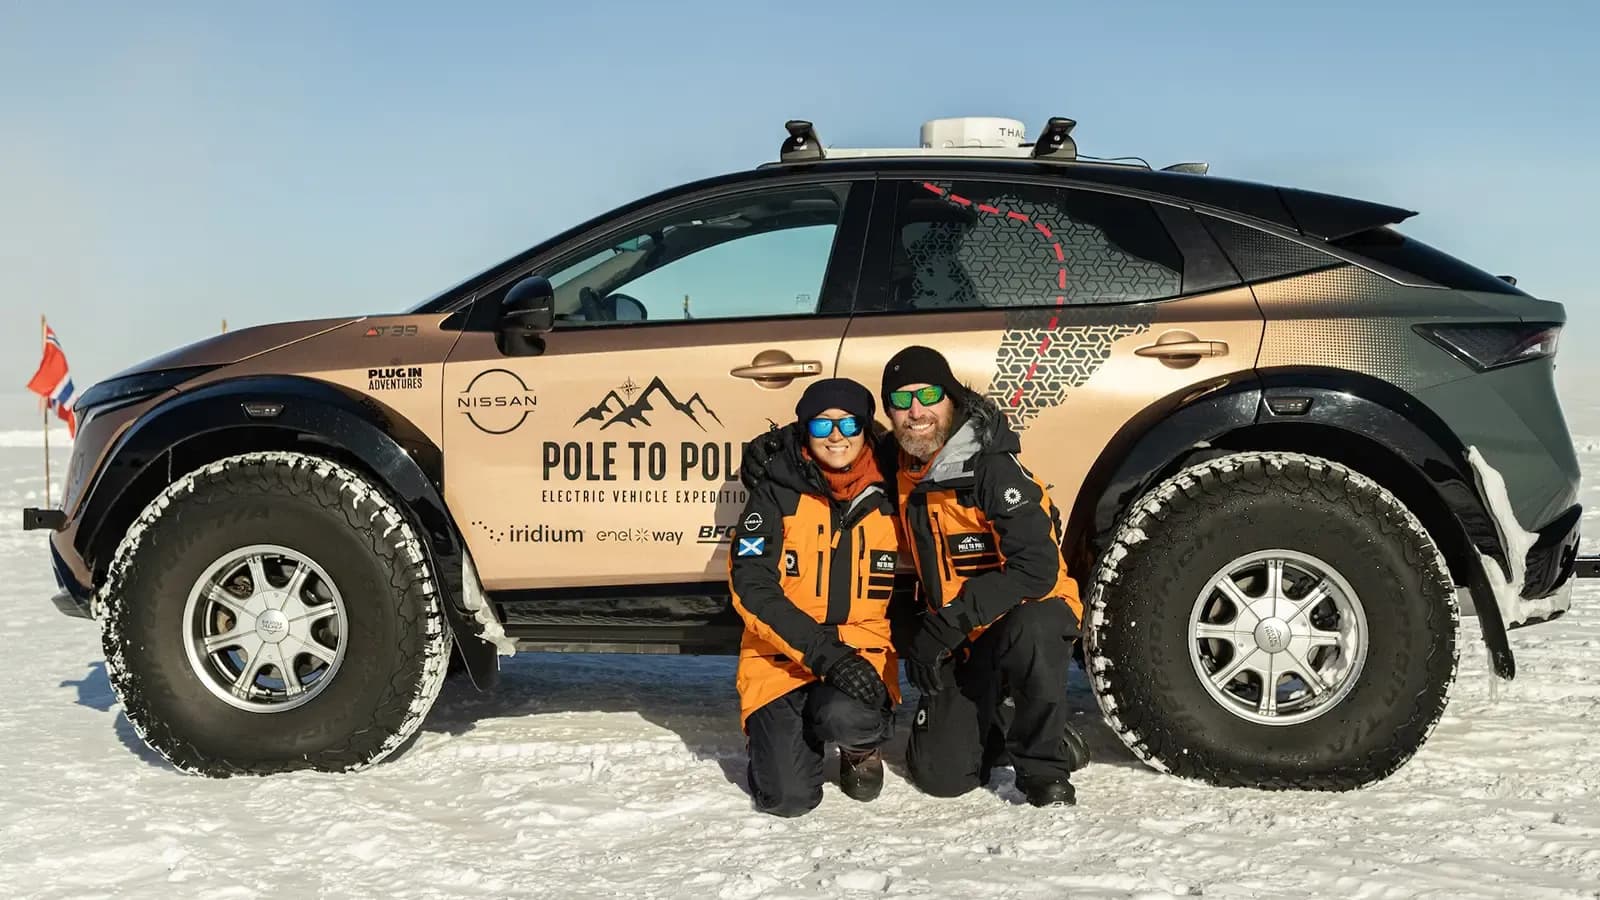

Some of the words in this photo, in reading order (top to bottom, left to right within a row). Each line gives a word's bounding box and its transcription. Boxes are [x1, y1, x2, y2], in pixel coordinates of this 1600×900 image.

[368, 368, 406, 379] PLUG
[408, 367, 422, 377] IN
[368, 378, 423, 390] ADVENTURES
[457, 395, 537, 408] NISSAN
[542, 441, 617, 481] POLE
[628, 441, 667, 481] TO
[542, 490, 605, 503] ELECTRIC
[613, 490, 668, 503] VEHICLE
[676, 490, 746, 503] EXPEDITIO
[510, 524, 584, 542] iridium
[596, 528, 633, 541] enel
[652, 531, 684, 545] way
